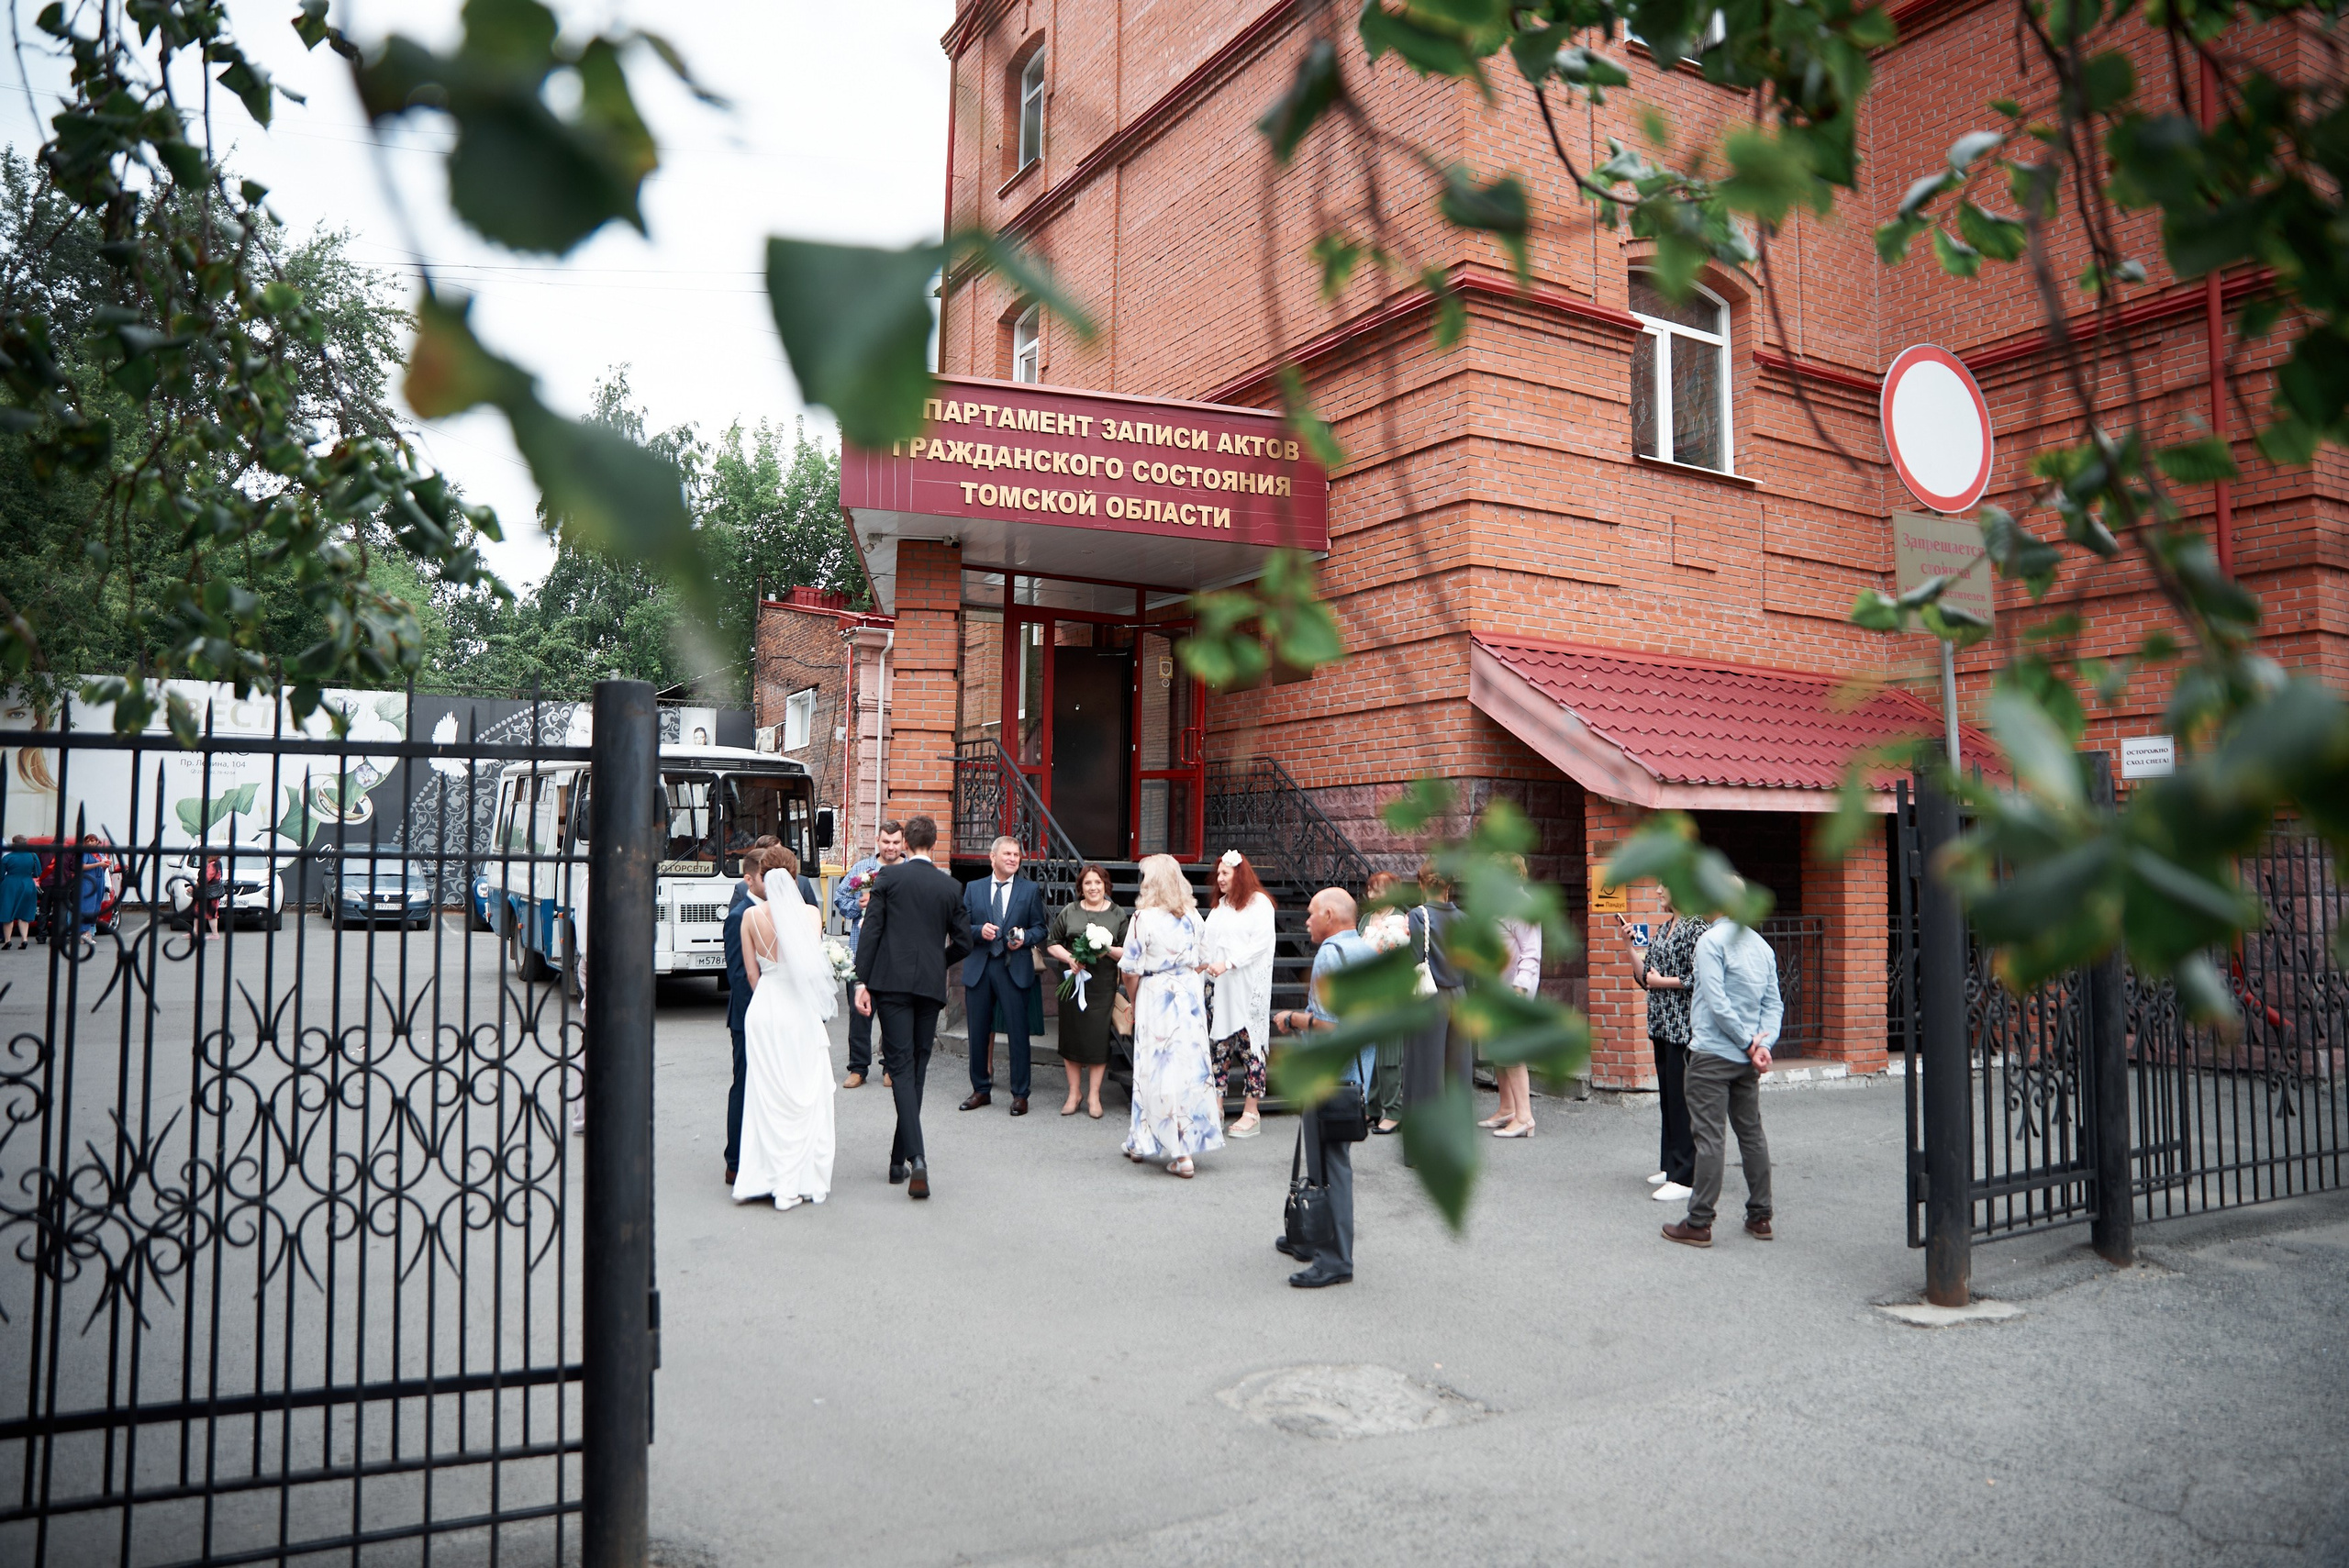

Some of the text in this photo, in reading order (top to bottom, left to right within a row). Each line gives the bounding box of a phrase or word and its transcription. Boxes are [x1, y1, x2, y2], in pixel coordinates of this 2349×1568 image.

[922, 398, 1300, 461] ПАРТАМЕНТ ЗАПИСИ АКТОВ
[893, 436, 1291, 497] ГРАЖДАНСКОГО СОСТОЯНИЯ
[960, 481, 1230, 529] ТОМСКОЙ ОБЛАСТИ
[1902, 532, 1986, 558] Запрещается
[156, 698, 295, 729] ВЕСТА
[180, 759, 194, 767] Пр.
[196, 760, 229, 768] Леина,
